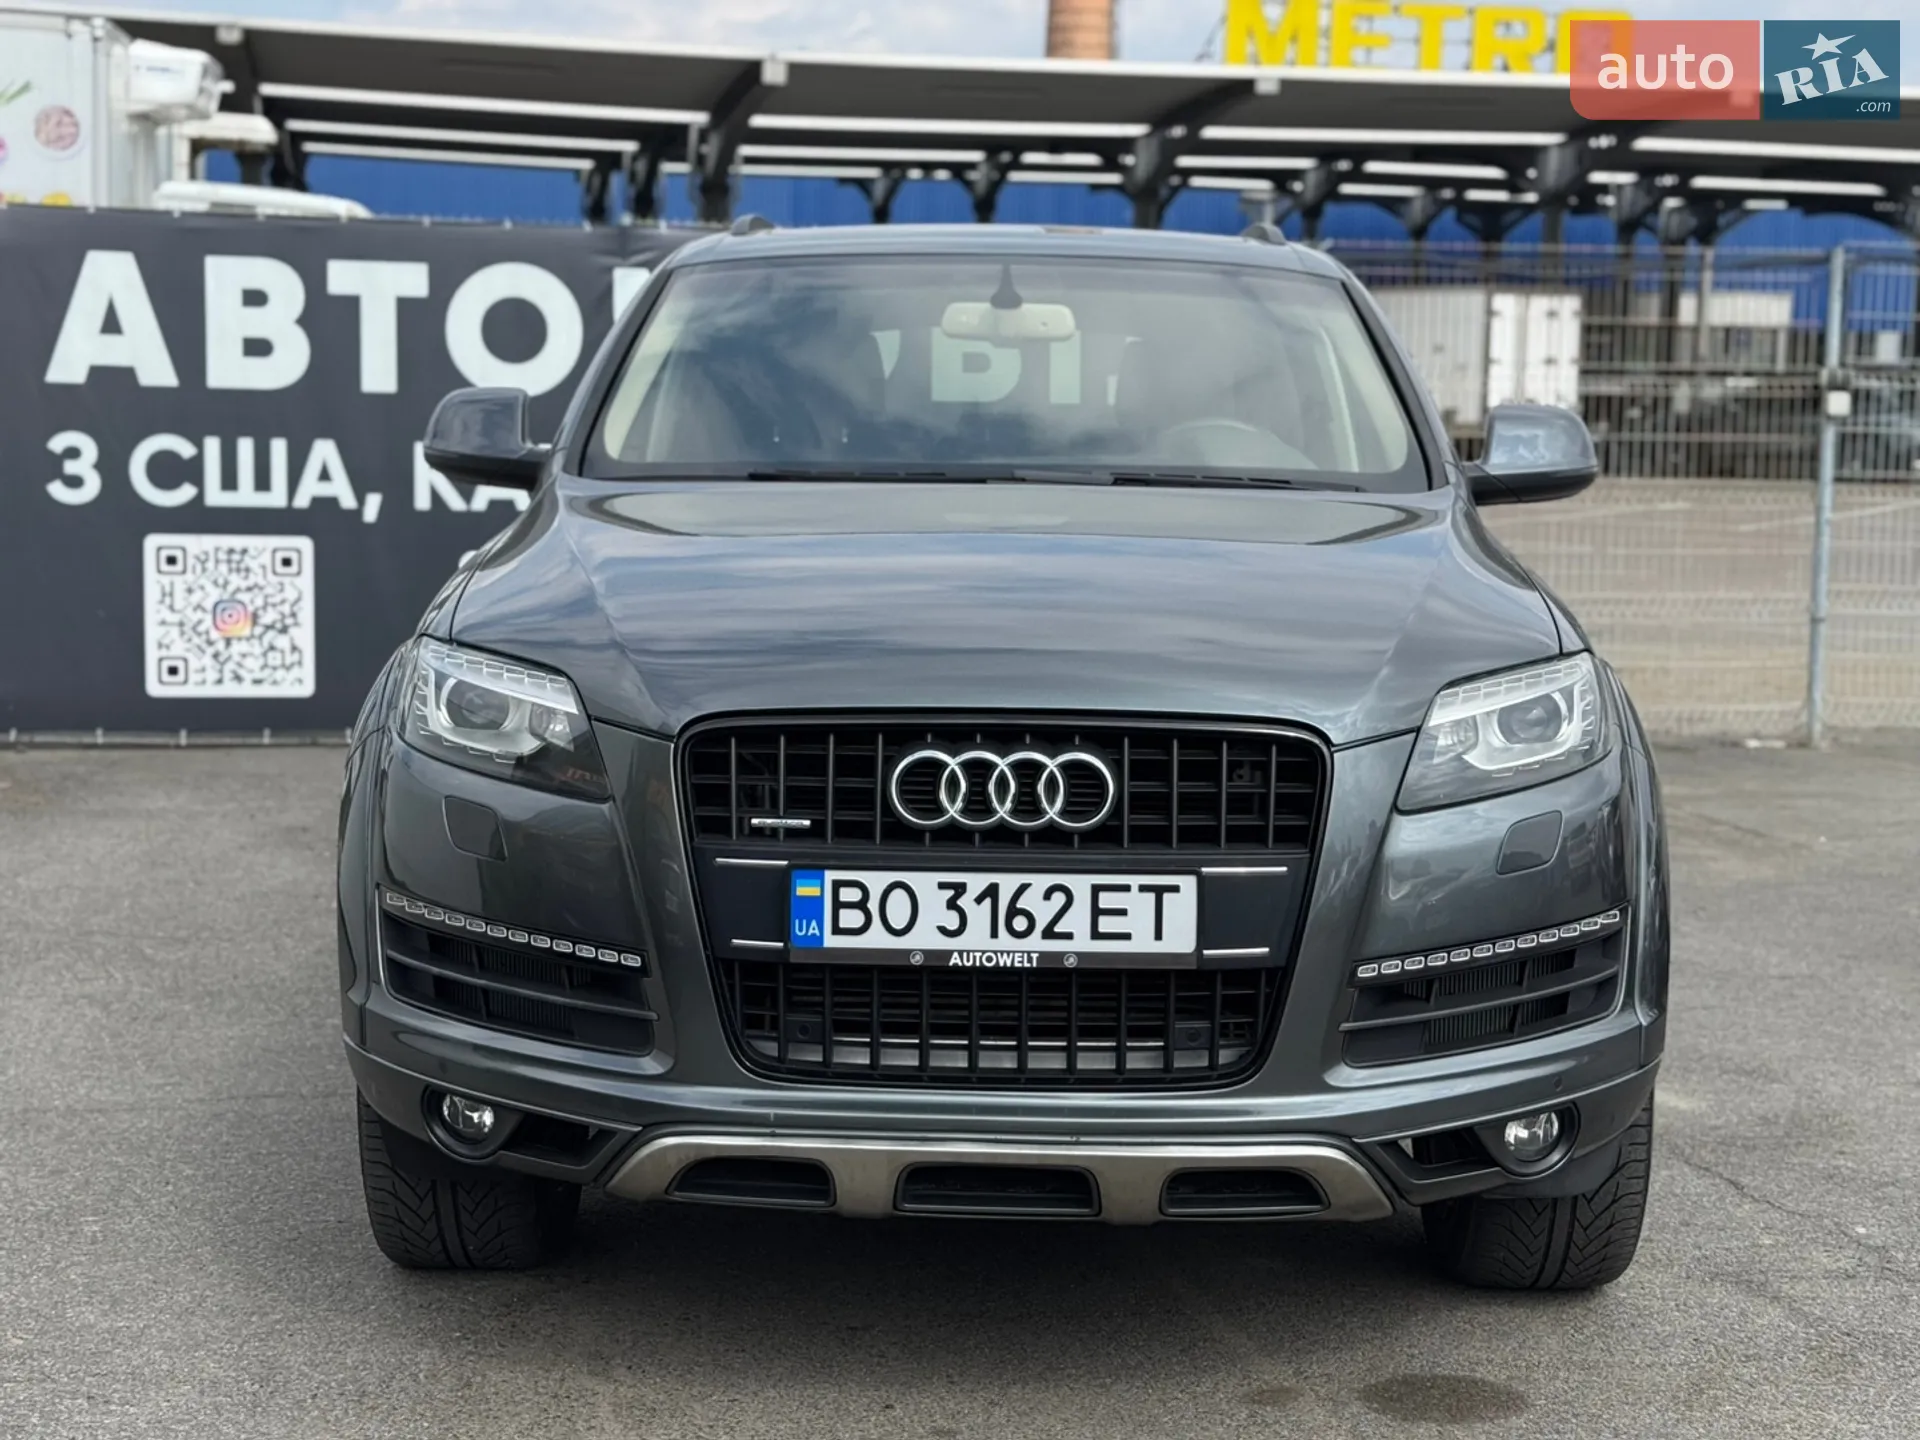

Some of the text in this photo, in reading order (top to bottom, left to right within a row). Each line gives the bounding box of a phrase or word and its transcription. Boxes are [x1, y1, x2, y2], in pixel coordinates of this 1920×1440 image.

[1223, 0, 1635, 75] METRO
[45, 249, 650, 399] АВТО
[128, 432, 383, 524] США,
[794, 918, 821, 937] UA
[831, 879, 1182, 942] BO 3162 ET
[948, 951, 1040, 968] AUTOWELT
